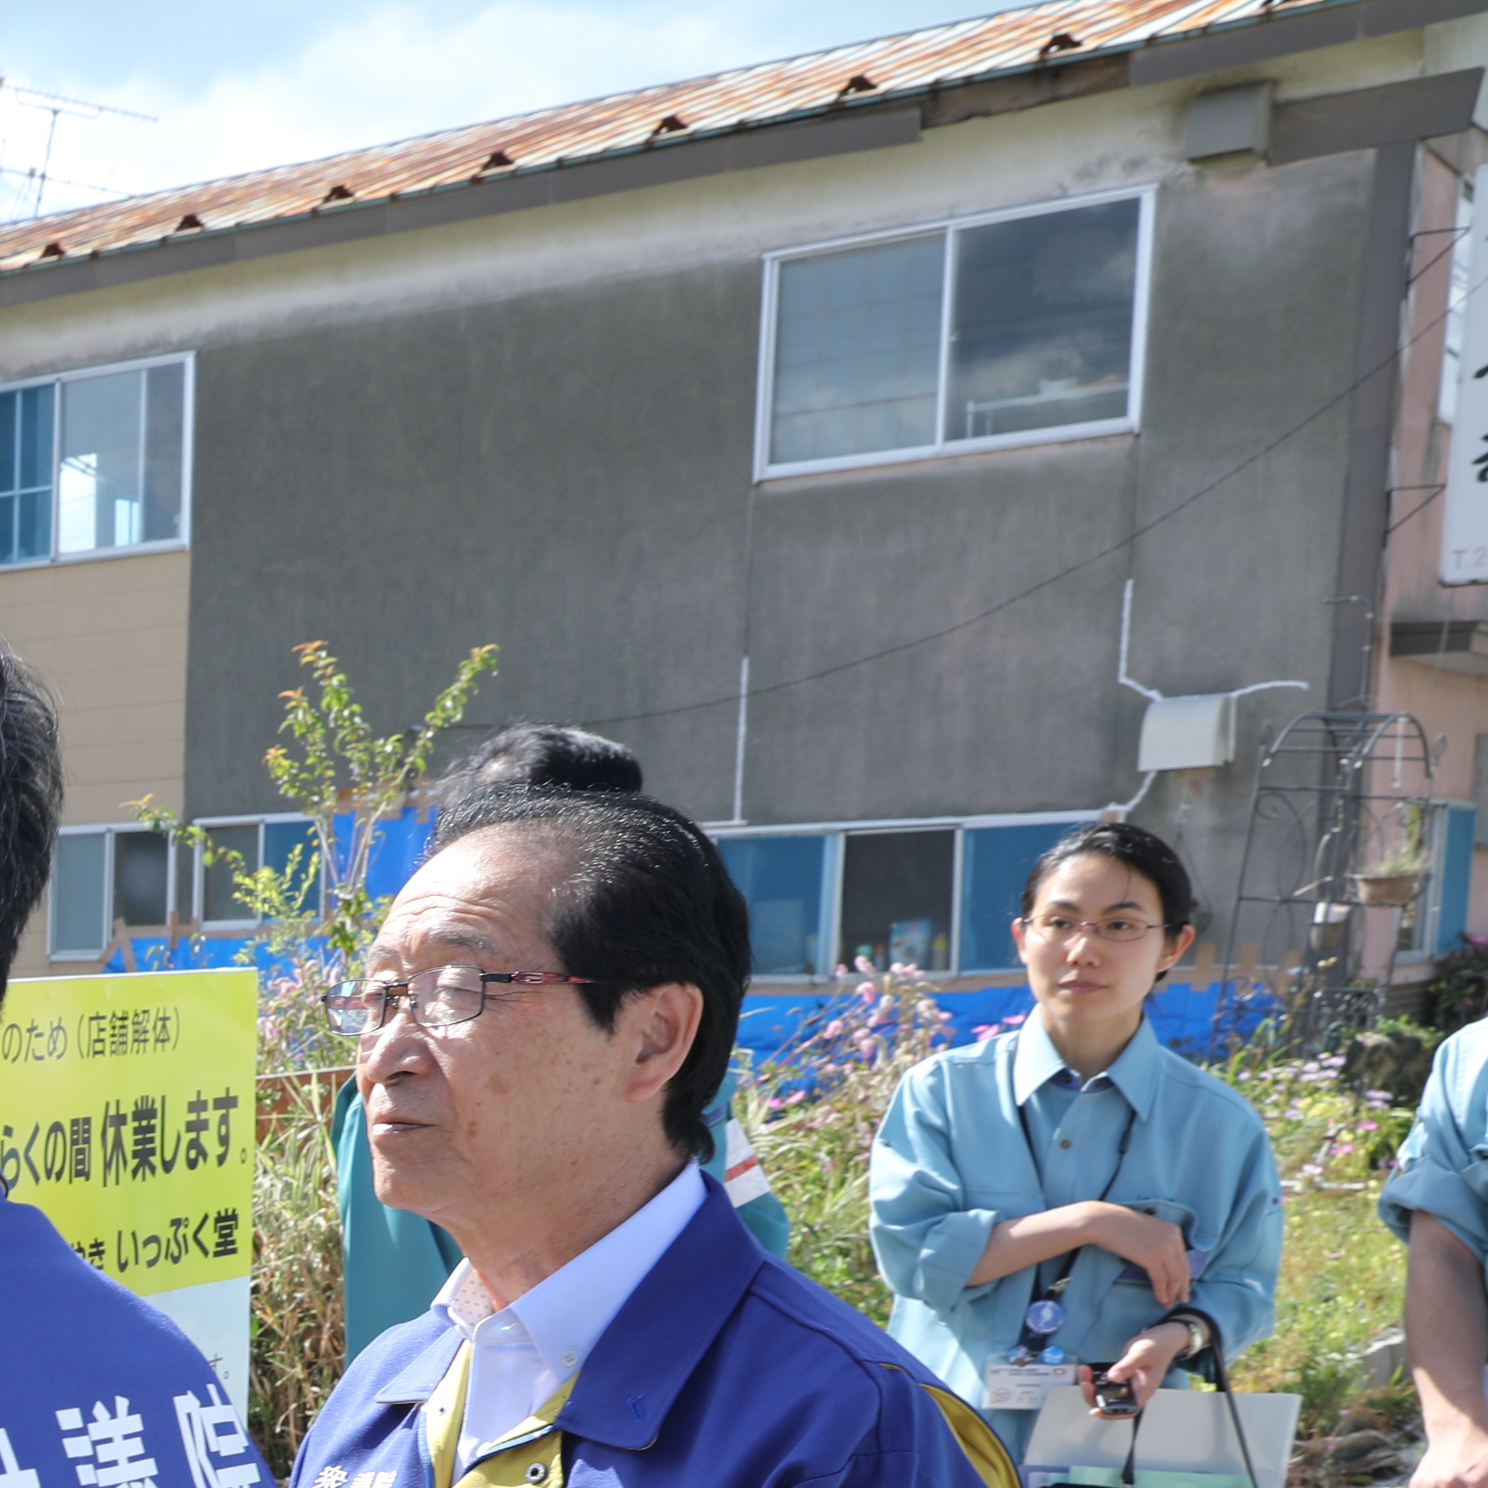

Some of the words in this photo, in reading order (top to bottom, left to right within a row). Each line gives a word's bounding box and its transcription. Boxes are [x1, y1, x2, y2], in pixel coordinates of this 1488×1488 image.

[117, 1208, 239, 1273] いっぷく堂
